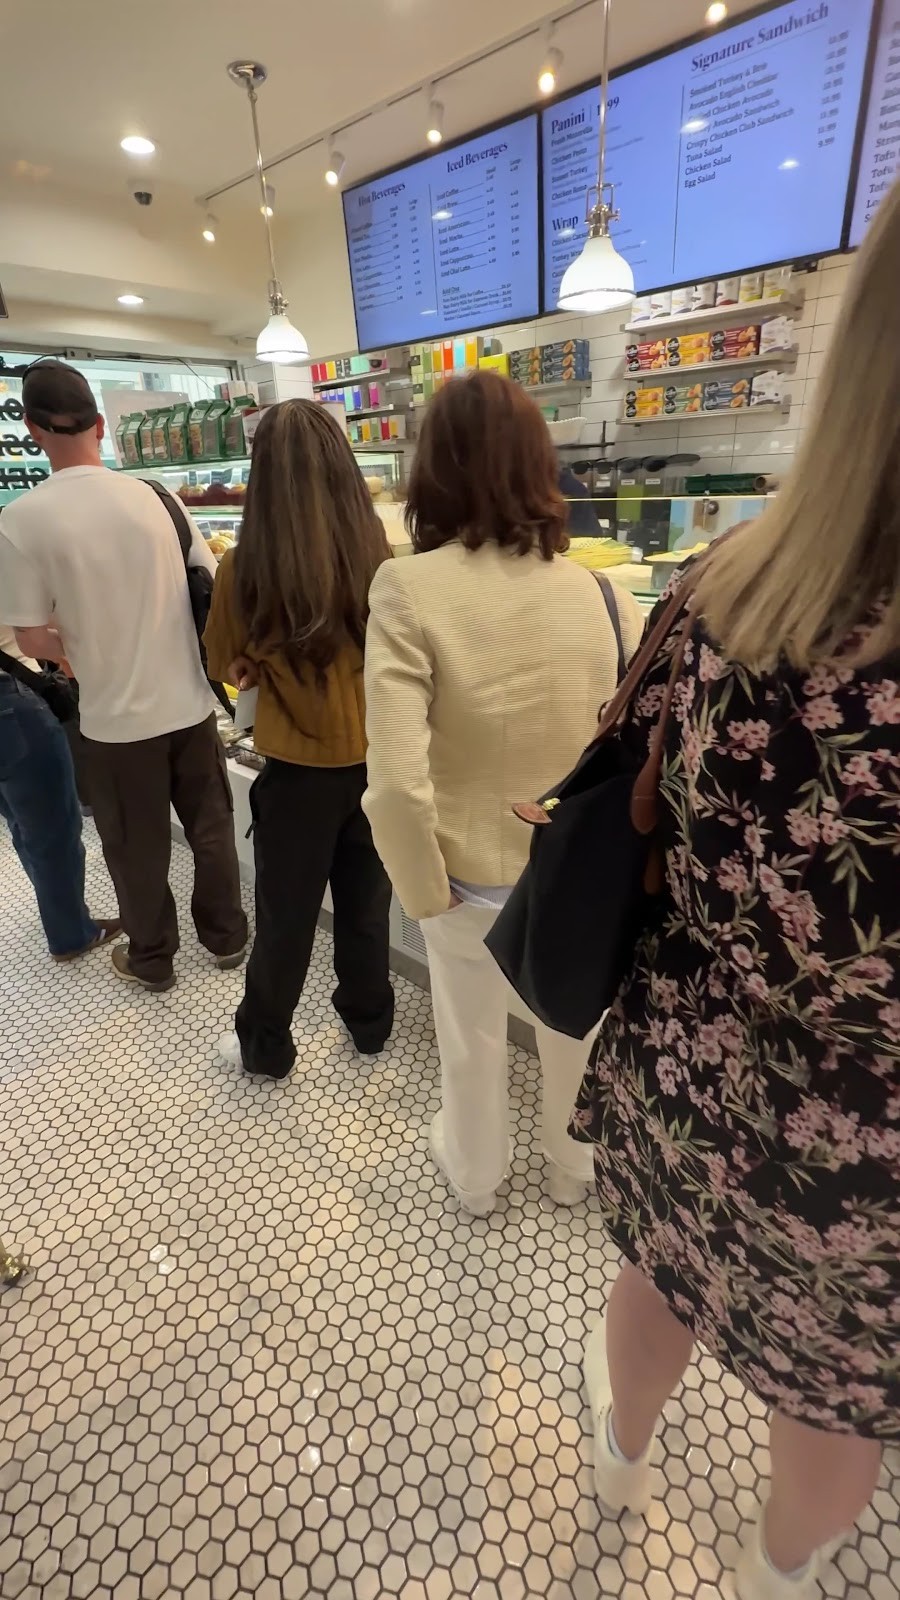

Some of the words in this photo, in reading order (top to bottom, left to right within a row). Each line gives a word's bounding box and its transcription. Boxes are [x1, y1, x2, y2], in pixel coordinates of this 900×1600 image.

[691, 36, 754, 72] Signature
[757, 2, 829, 45] Sandwich
[690, 95, 719, 110] Avocado
[712, 99, 741, 115] Chicken
[742, 88, 774, 104] Avocado
[551, 108, 585, 135] Panini
[713, 112, 743, 128] Avocado
[744, 99, 780, 118] Sandwich
[686, 138, 709, 151] Crispy
[710, 127, 738, 143] Chicken
[739, 120, 756, 133] Club
[757, 107, 794, 127] Sandwich
[447, 155, 464, 173] Iced
[465, 143, 508, 166] Beverages
[552, 153, 572, 165] Chicken
[686, 152, 703, 163] Tuna
[703, 144, 723, 158] Salad
[873, 150, 896, 163] Tofu
[685, 161, 712, 176] Chicken
[713, 154, 732, 167] Salad
[871, 166, 894, 179] Tofu
[684, 177, 697, 189] Egg
[697, 171, 716, 184] Salad
[372, 183, 406, 201] Beverages
[552, 188, 572, 200] Chicken
[552, 216, 579, 231] Wrap
[552, 235, 572, 246] Chicken
[552, 253, 570, 263] Turkey
